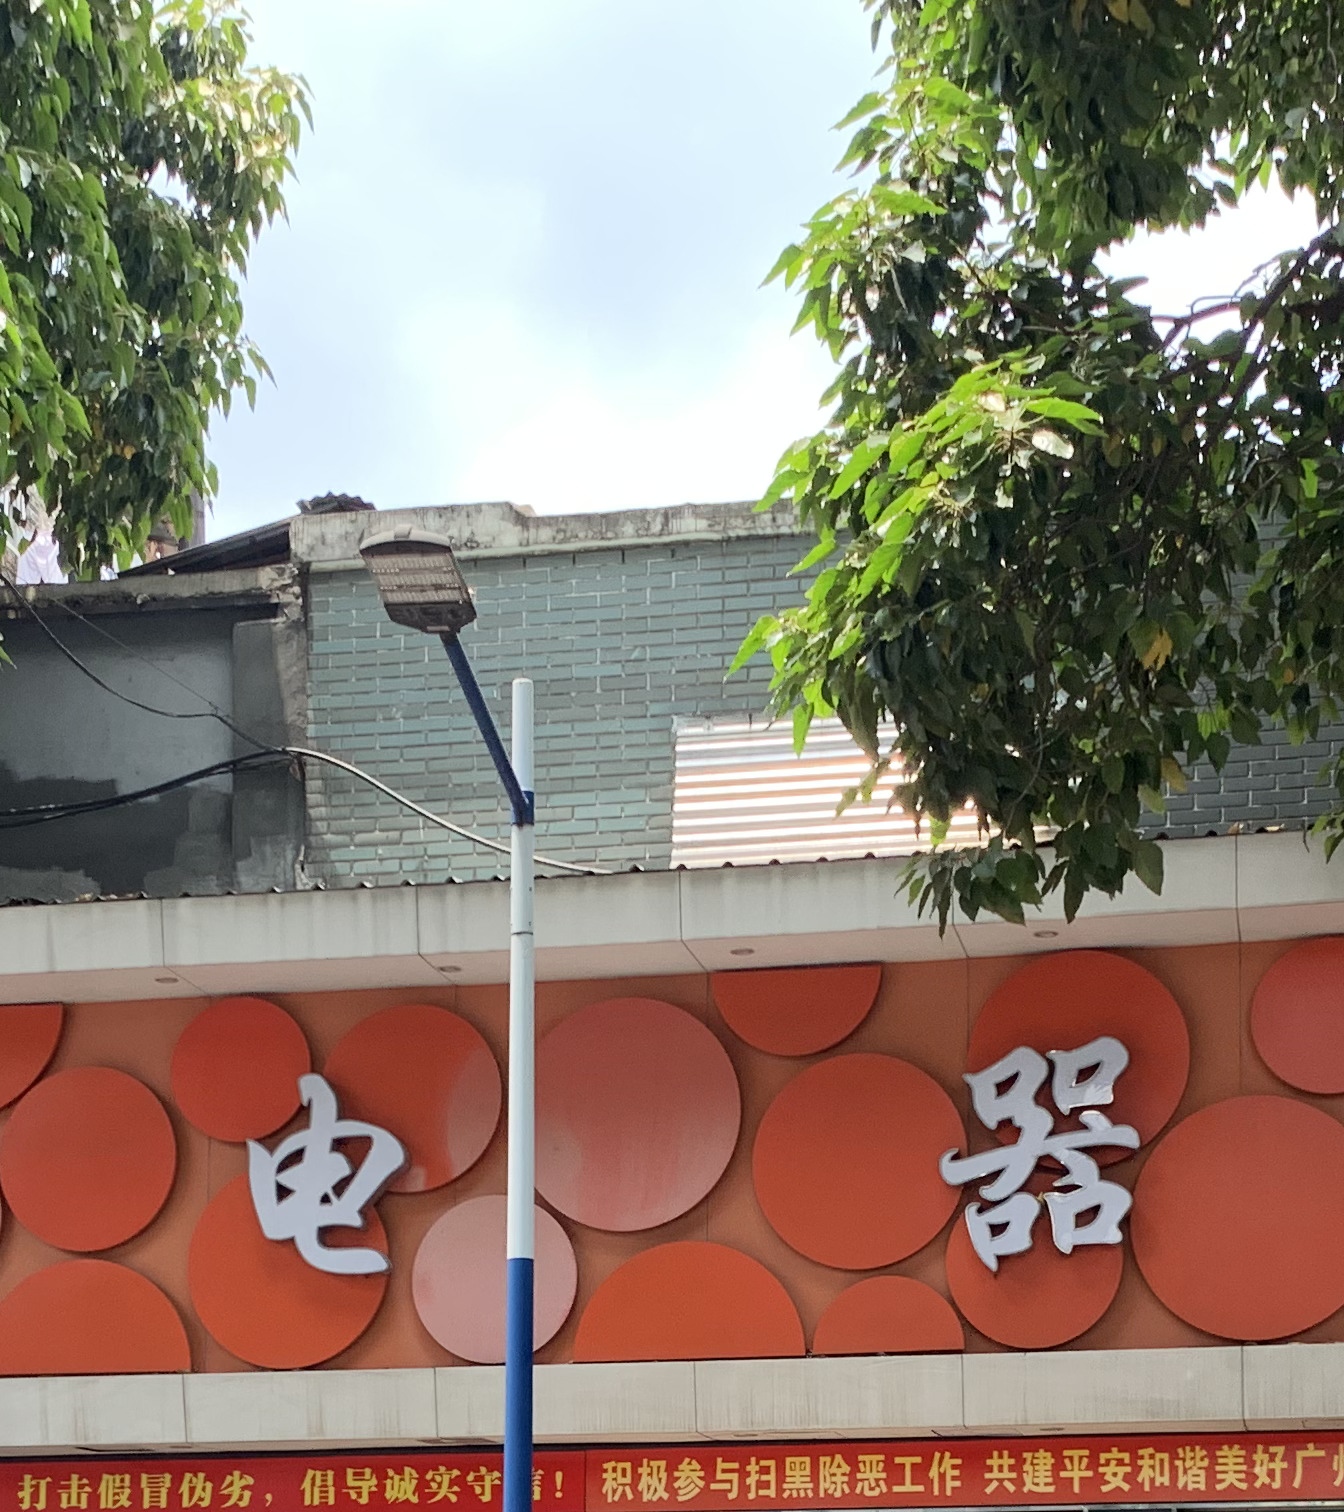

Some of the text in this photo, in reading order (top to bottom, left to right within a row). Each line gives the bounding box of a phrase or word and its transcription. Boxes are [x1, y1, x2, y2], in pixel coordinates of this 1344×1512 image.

[17, 1466, 566, 1511] 打击假冒伪劣，倡导诚实守！
[601, 1454, 963, 1503] 积极参与扫黑除恶工作
